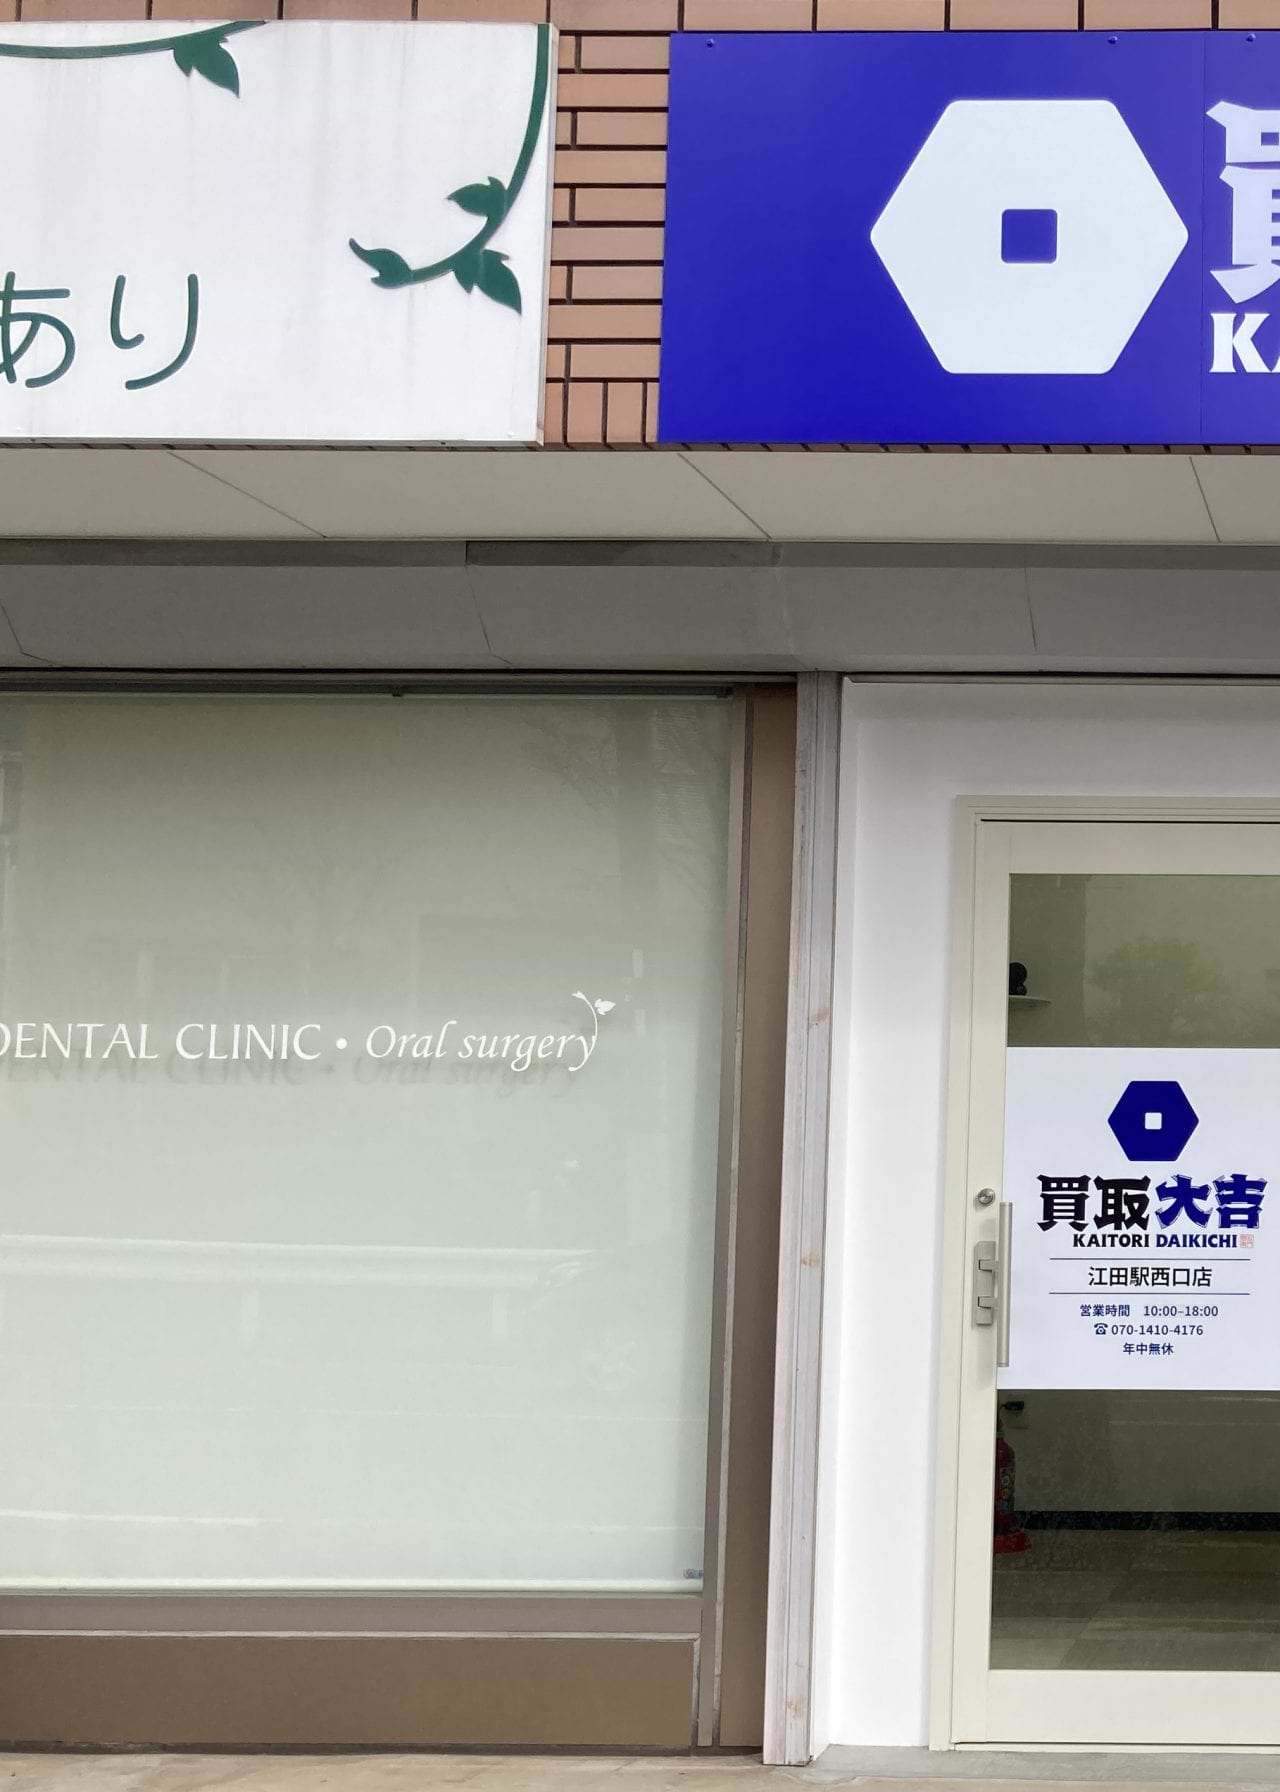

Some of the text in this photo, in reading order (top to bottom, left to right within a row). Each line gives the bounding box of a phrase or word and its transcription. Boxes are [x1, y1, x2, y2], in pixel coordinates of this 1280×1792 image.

[0, 271, 199, 391] あり
[175, 1022, 321, 1061] CLINIC
[366, 1020, 457, 1059] Oral
[457, 1027, 598, 1072] surgery
[1036, 1173, 1268, 1232] 買取大吉
[1072, 1233, 1150, 1249] KAITORI
[1155, 1233, 1238, 1249] DAIKICHI
[1087, 1265, 1214, 1288] 江田駅西口店
[1079, 1303, 1131, 1318] 営業時間
[1111, 1324, 1204, 1336] 070-1410-4176
[1122, 1342, 1174, 1356] 年中無休
